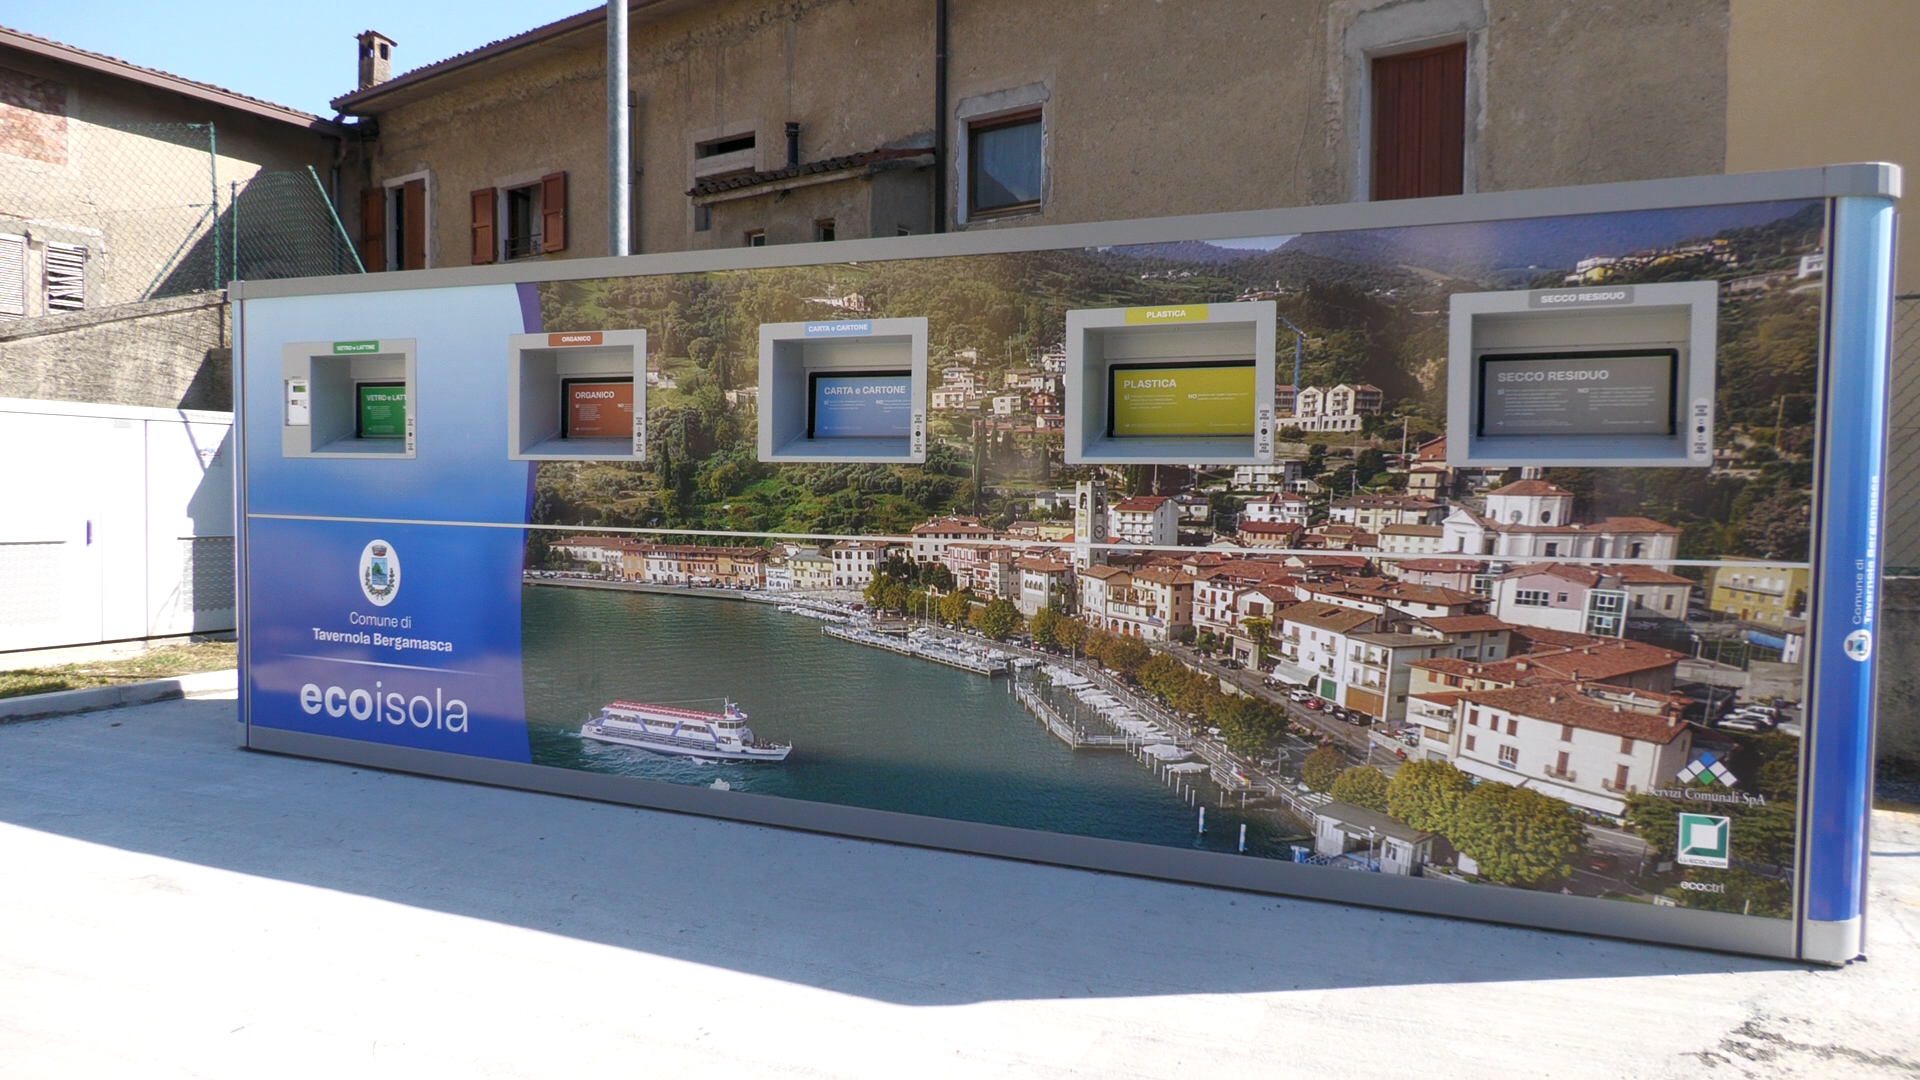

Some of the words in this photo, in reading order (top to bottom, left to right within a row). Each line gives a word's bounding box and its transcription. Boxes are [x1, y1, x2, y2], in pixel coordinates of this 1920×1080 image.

[1541, 294, 1577, 304] SECCO
[1578, 291, 1626, 302] RESIDUO
[1146, 310, 1186, 319] PLASTICA
[808, 325, 830, 333] CARTA
[836, 322, 868, 332] CARTONE
[561, 335, 592, 343] ORGANICO
[1497, 371, 1545, 383] SECCO
[1547, 370, 1610, 382] RESIDUO
[823, 386, 854, 395] CARTA
[862, 385, 906, 395] CARTONE
[1123, 379, 1177, 389] PLASTICA
[575, 391, 615, 399] ORGANICO
[1855, 558, 1865, 571] di
[1852, 571, 1865, 625] Comune
[1863, 559, 1876, 625] Tavernola
[349, 611, 399, 628] Comune
[400, 615, 412, 629] di
[312, 627, 371, 645] Tavernola
[373, 632, 453, 653] Bergamasca
[300, 681, 468, 733] ecoisola
[1684, 787, 1740, 804] Comunali
[1742, 791, 1767, 808] SpA
[1680, 880, 1725, 894] ecoctrl
